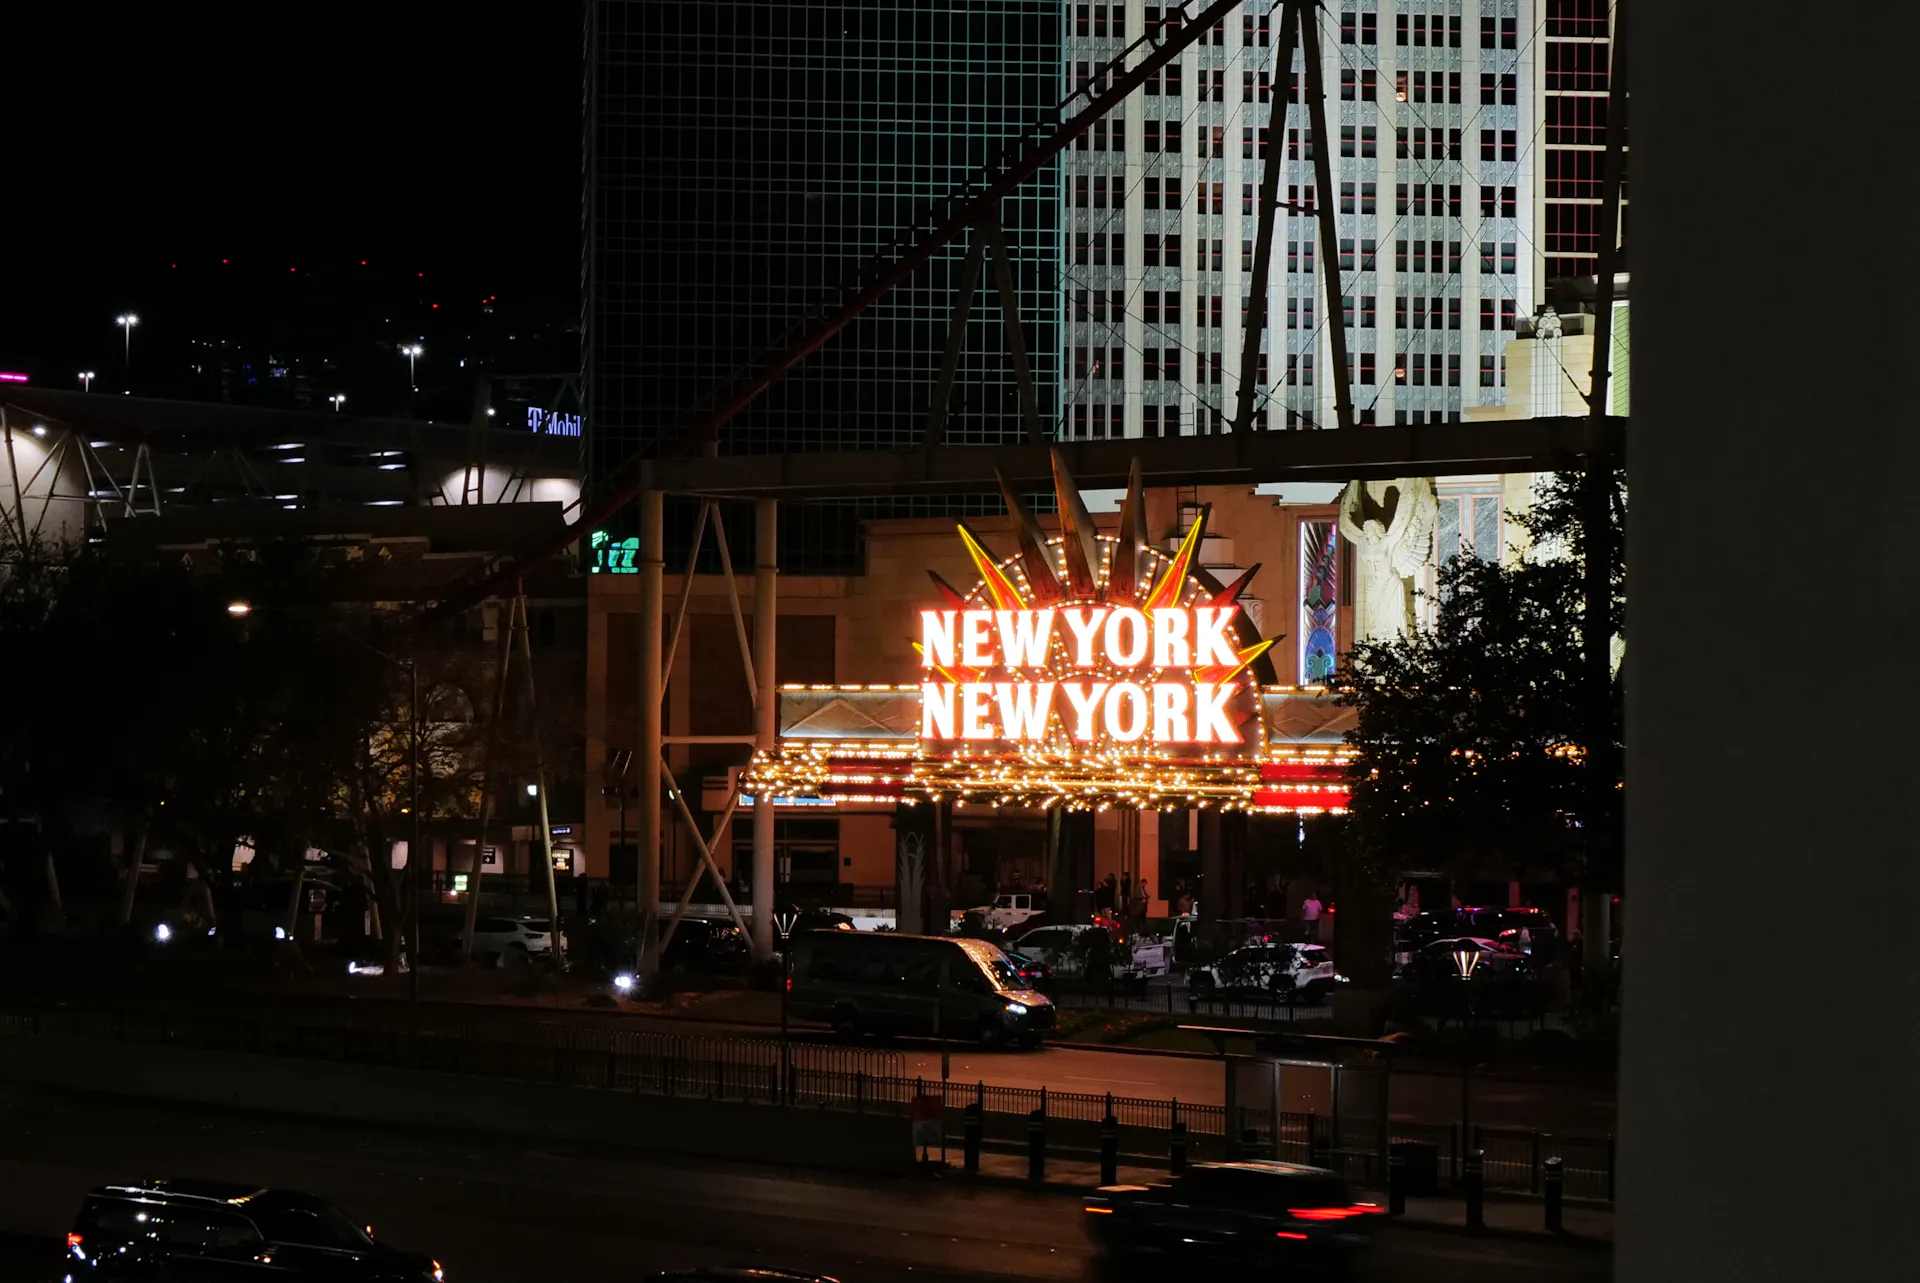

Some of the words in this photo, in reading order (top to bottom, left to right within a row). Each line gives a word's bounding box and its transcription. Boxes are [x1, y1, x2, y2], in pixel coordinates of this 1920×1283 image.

[919, 608, 1055, 668] NEW
[1060, 606, 1242, 668] YORK
[919, 681, 1055, 742] NEW
[1060, 682, 1246, 744] YORK
